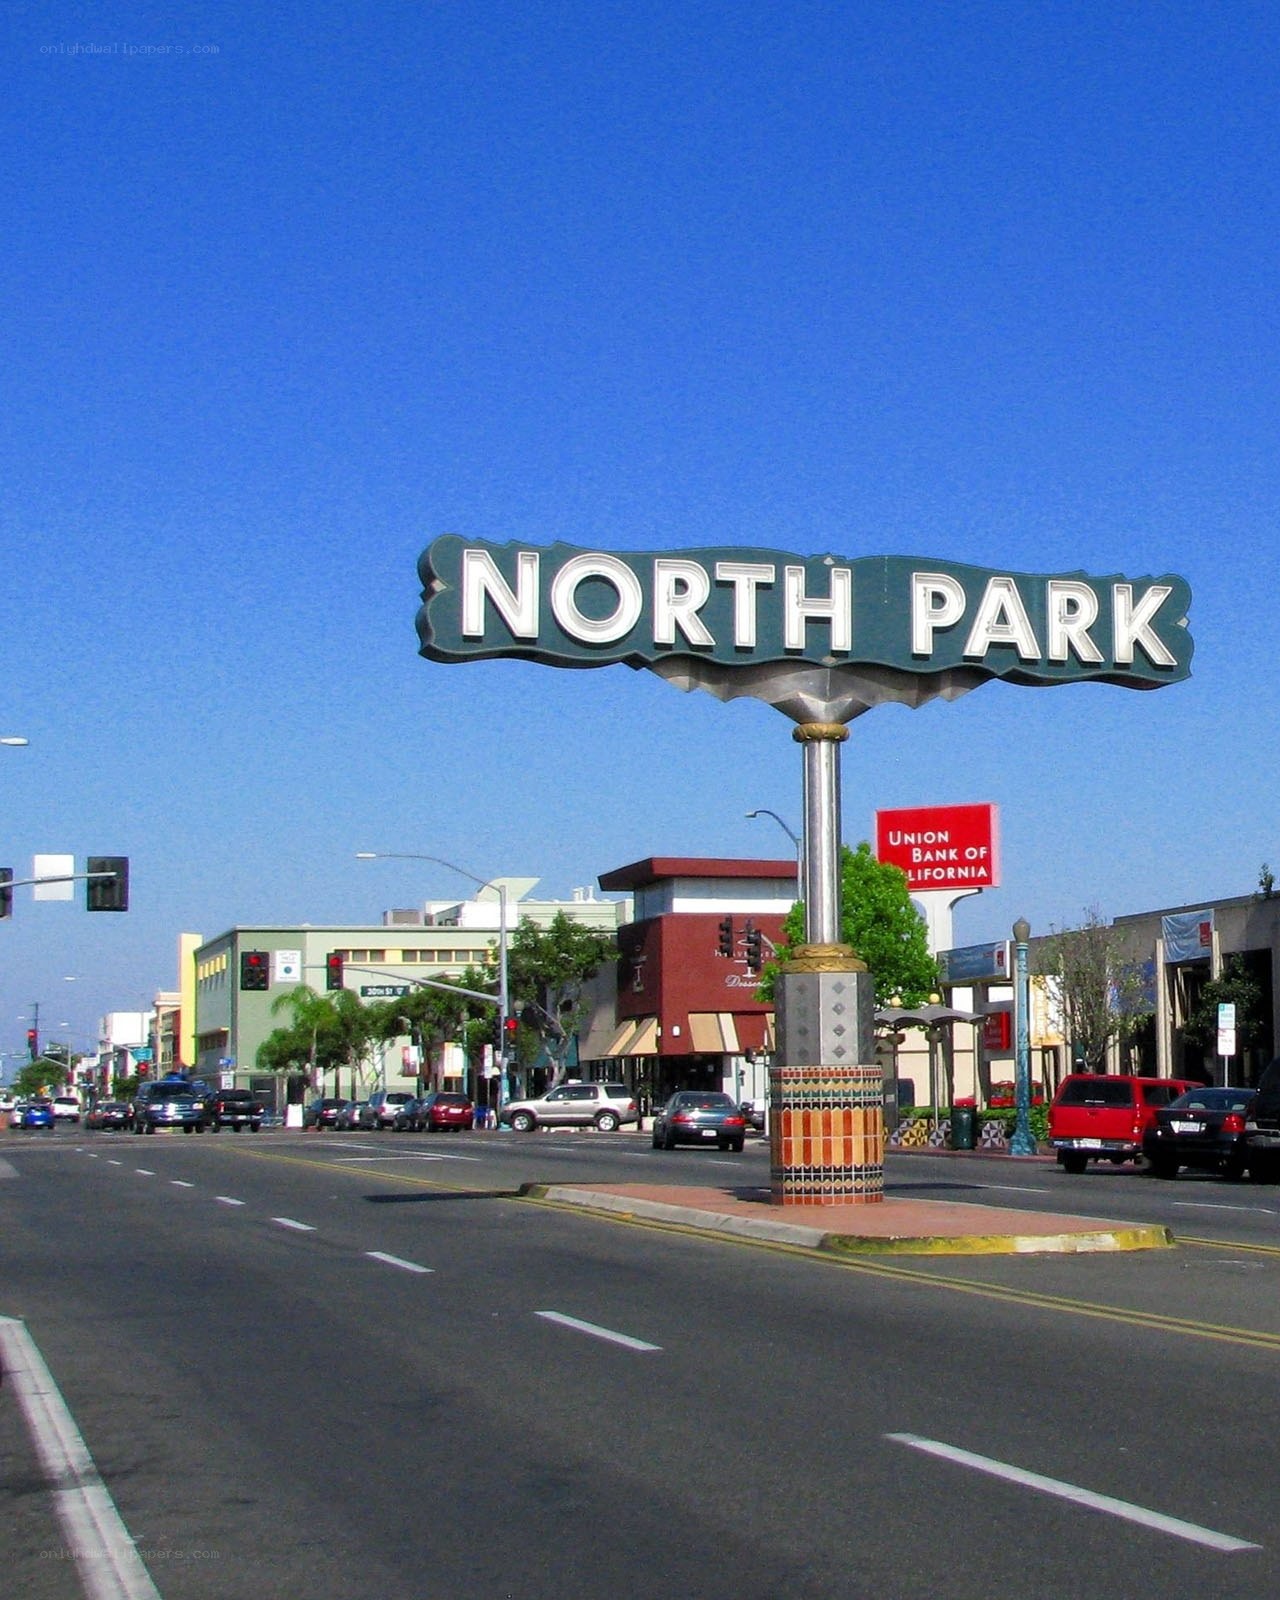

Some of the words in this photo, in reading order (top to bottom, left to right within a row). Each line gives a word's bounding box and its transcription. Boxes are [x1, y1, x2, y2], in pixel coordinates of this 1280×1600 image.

[461, 549, 853, 653] NORTH
[910, 571, 1179, 667] PARK
[888, 831, 950, 846] UNION
[912, 847, 959, 863] BANK
[964, 846, 988, 860] OF
[907, 865, 989, 882] LIFORNIA
